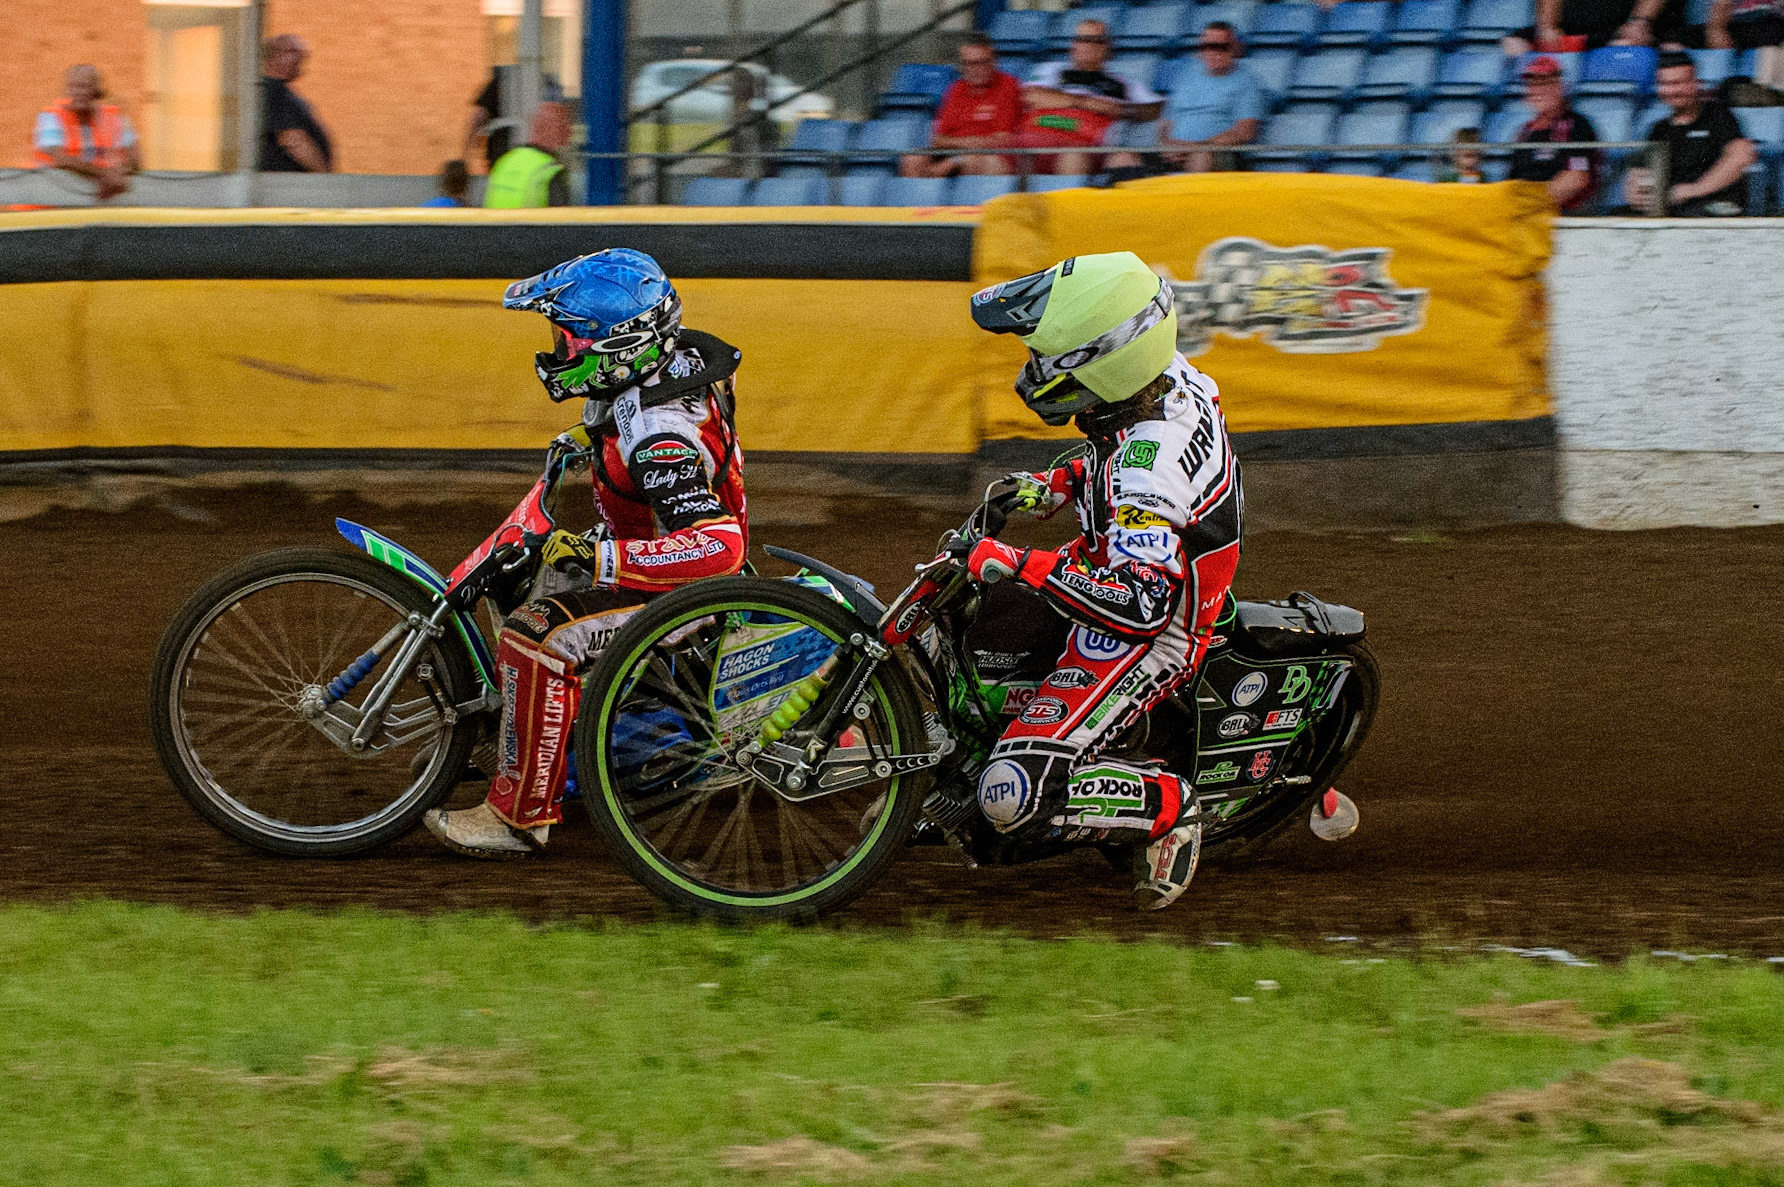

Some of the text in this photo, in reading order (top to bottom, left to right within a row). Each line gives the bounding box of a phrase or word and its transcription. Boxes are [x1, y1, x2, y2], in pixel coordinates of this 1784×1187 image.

[643, 469, 678, 489] Lady
[627, 547, 704, 567] ACCOUNTANCY
[719, 655, 770, 680] SHOCKS
[723, 643, 775, 669] HAGON
[544, 677, 565, 723] LIFTS
[529, 725, 561, 799] MERIDIAN
[984, 780, 1016, 804] ATPI
[1096, 779, 1143, 798] ROCK
